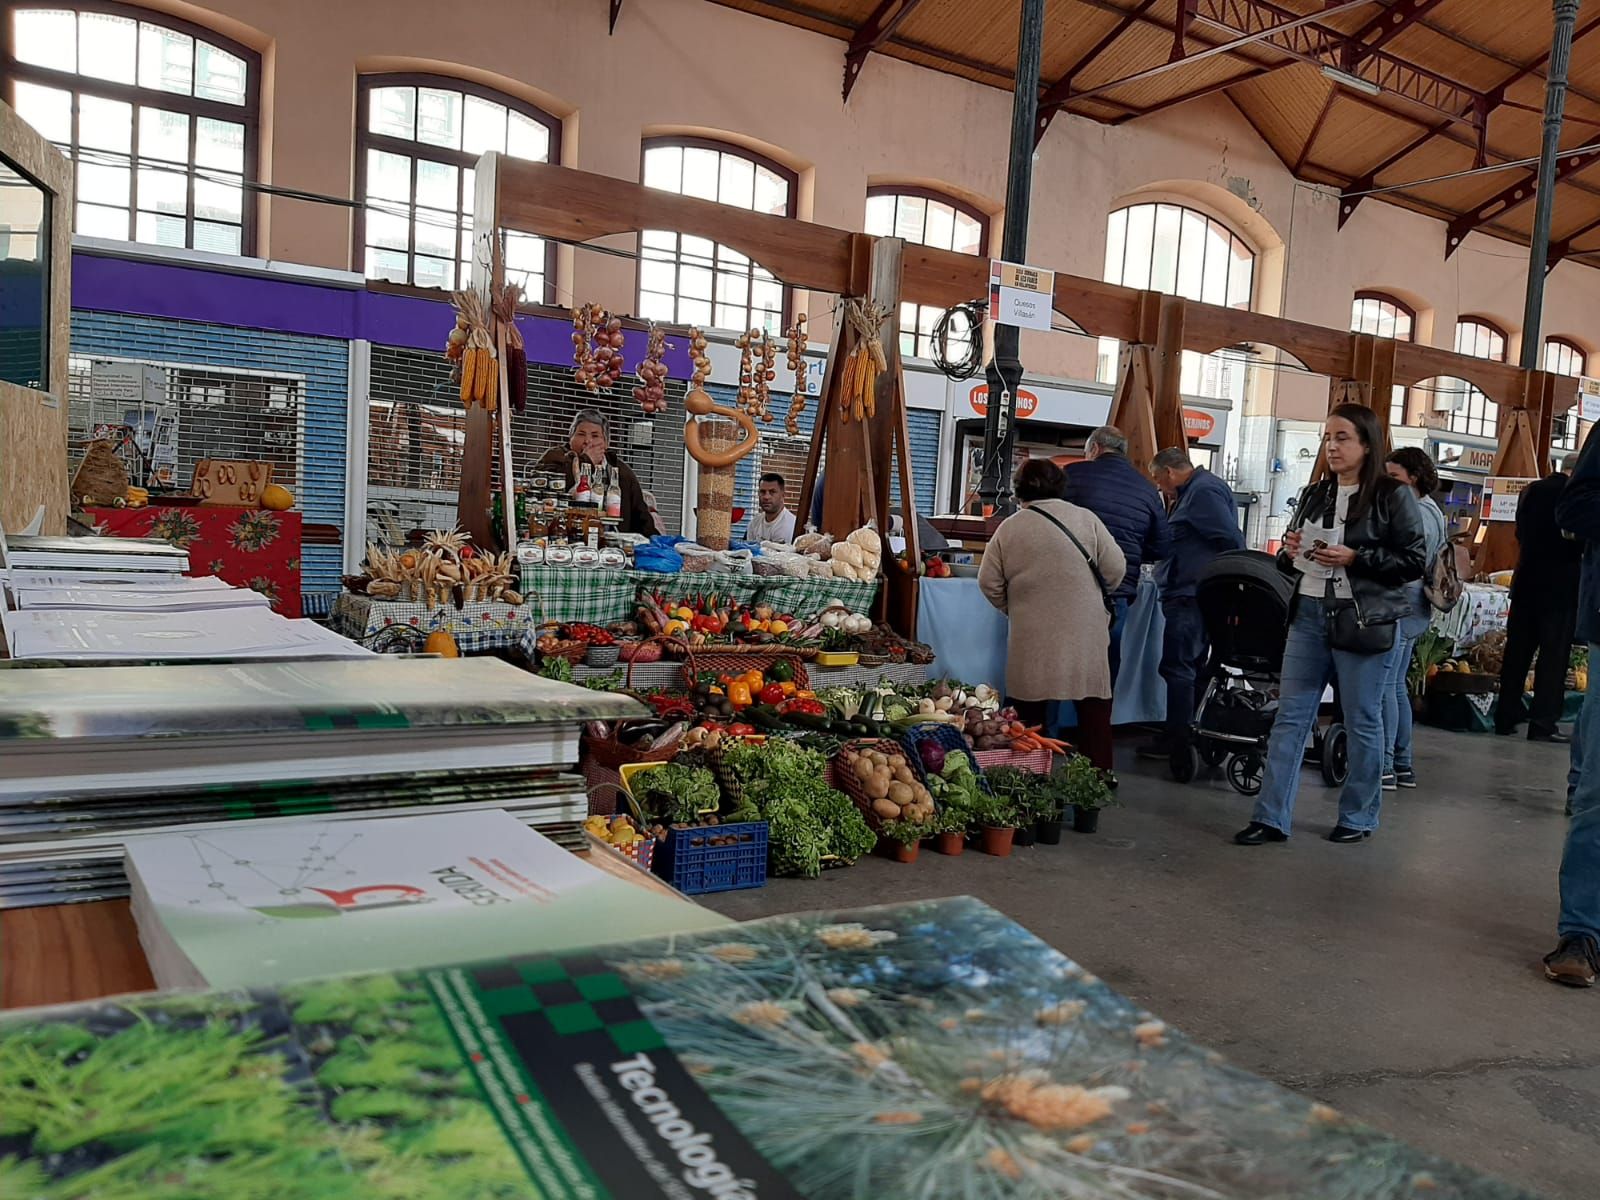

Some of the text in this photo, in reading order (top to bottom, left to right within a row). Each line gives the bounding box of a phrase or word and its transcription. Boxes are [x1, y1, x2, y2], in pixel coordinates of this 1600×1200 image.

[973, 391, 988, 405] LOS
[1470, 451, 1495, 467] MAR
[428, 865, 512, 906] SERIDA
